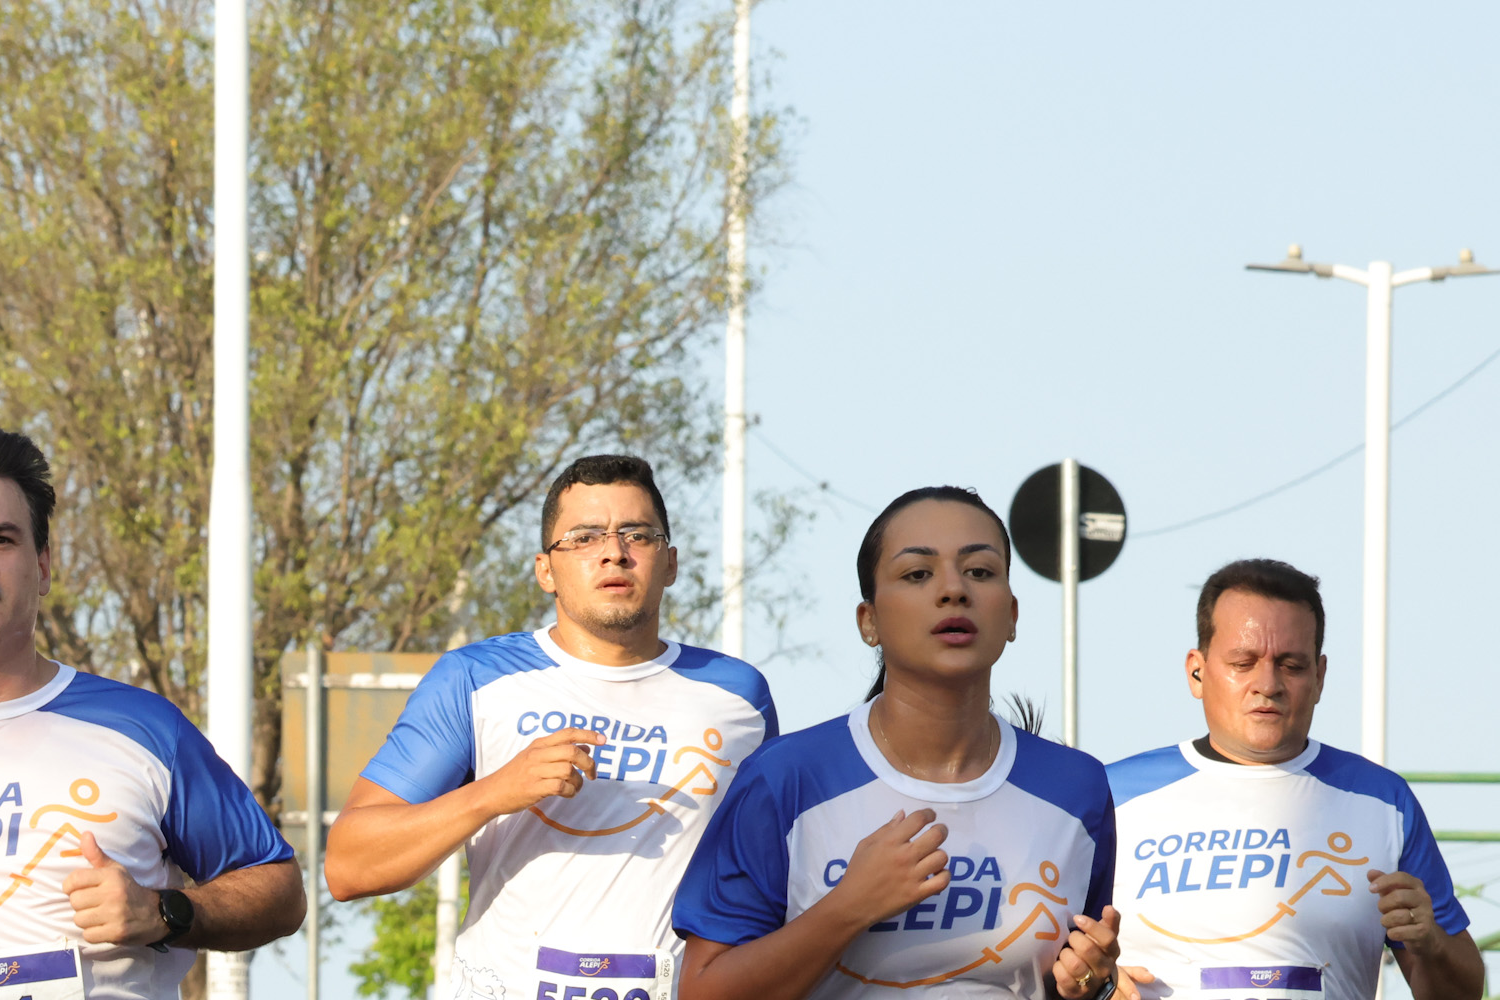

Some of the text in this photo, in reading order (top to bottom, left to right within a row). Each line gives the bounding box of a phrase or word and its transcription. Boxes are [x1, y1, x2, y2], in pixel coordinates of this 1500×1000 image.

[516, 711, 668, 744] CORRIDA
[574, 744, 668, 784] EPI
[1134, 828, 1291, 861] CORRIDA
[1136, 854, 1291, 900] ALEPI
[869, 887, 1002, 932] EPI
[579, 961, 601, 969] ALEPI
